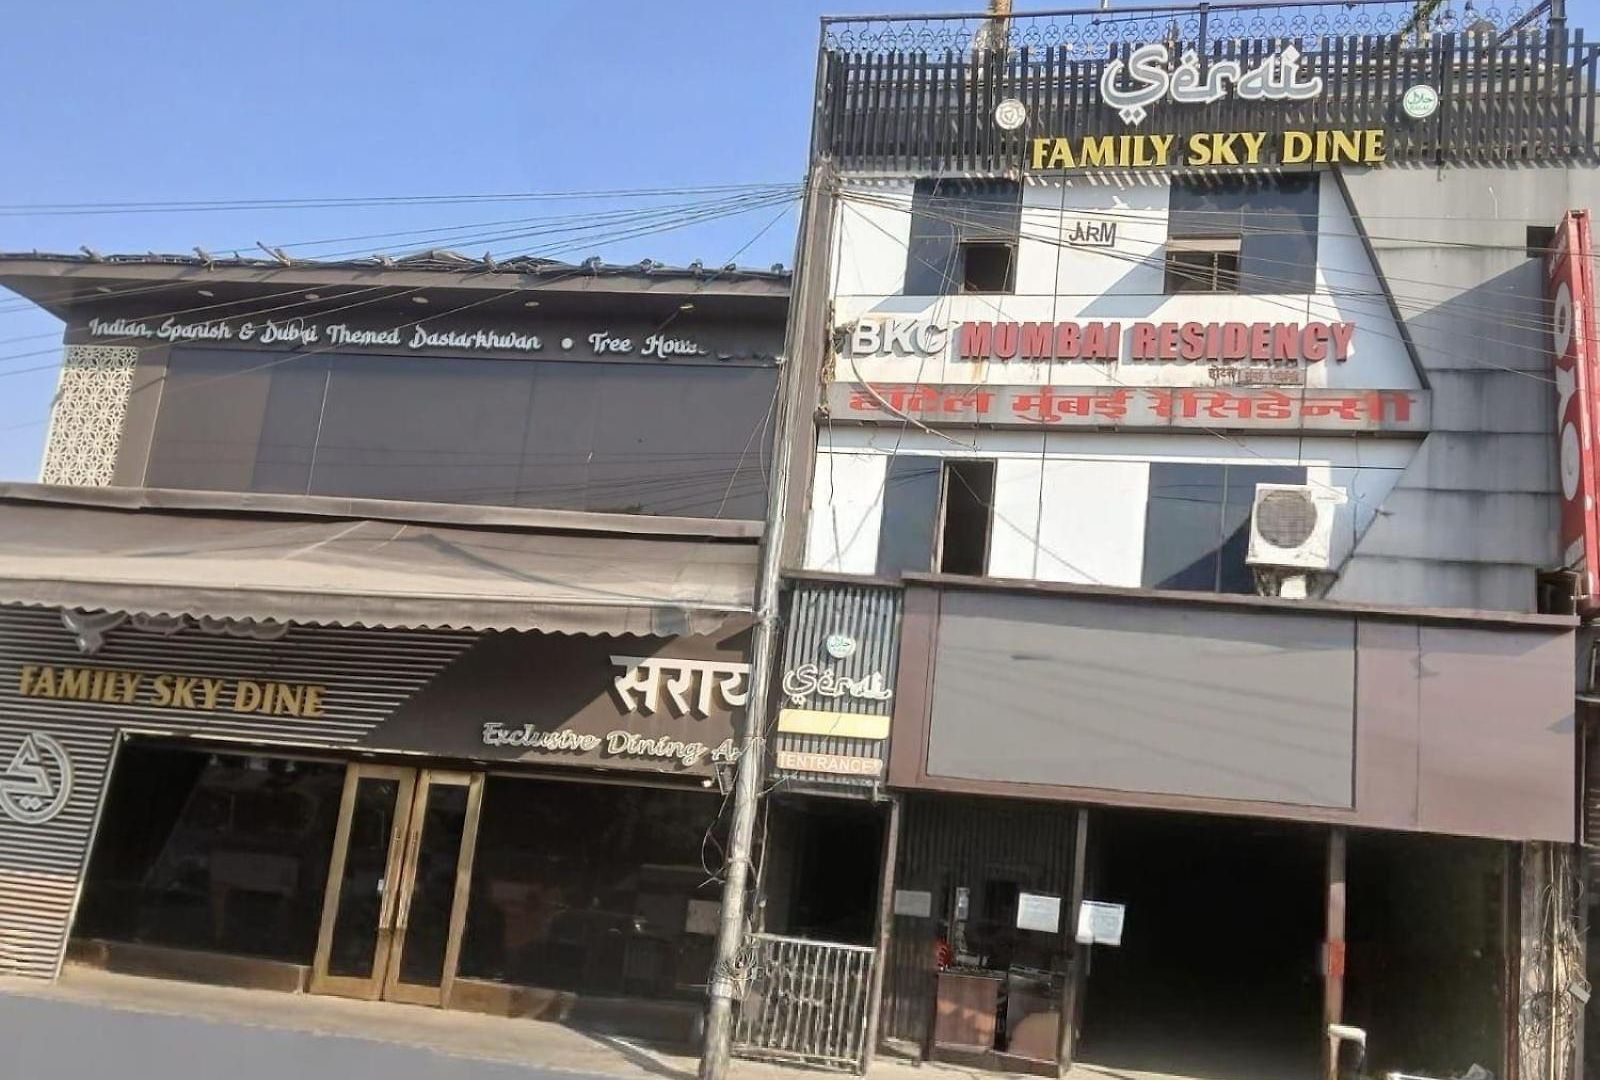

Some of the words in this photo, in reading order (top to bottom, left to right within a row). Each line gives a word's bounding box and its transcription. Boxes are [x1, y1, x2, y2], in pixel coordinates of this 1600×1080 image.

[1031, 133, 1174, 170] FAMILY
[1188, 130, 1267, 166] SKY
[1281, 128, 1387, 164] DINE
[89, 317, 152, 338] Indian,
[157, 317, 232, 341] Spanish
[239, 322, 255, 340] &
[260, 319, 319, 345] Dubai
[326, 324, 401, 346] Themed
[408, 324, 542, 350] Dastarkhwan
[588, 330, 633, 353] Tree
[959, 321, 1122, 361] MUMBAI
[1132, 321, 1355, 363] RESIDENCY
[19, 664, 145, 704] FAMILY
[151, 673, 228, 712] SKY
[232, 679, 327, 718] DINE
[482, 722, 601, 752] Exclusive
[606, 730, 709, 766] Dining
[787, 752, 871, 773] ENTRANCE
